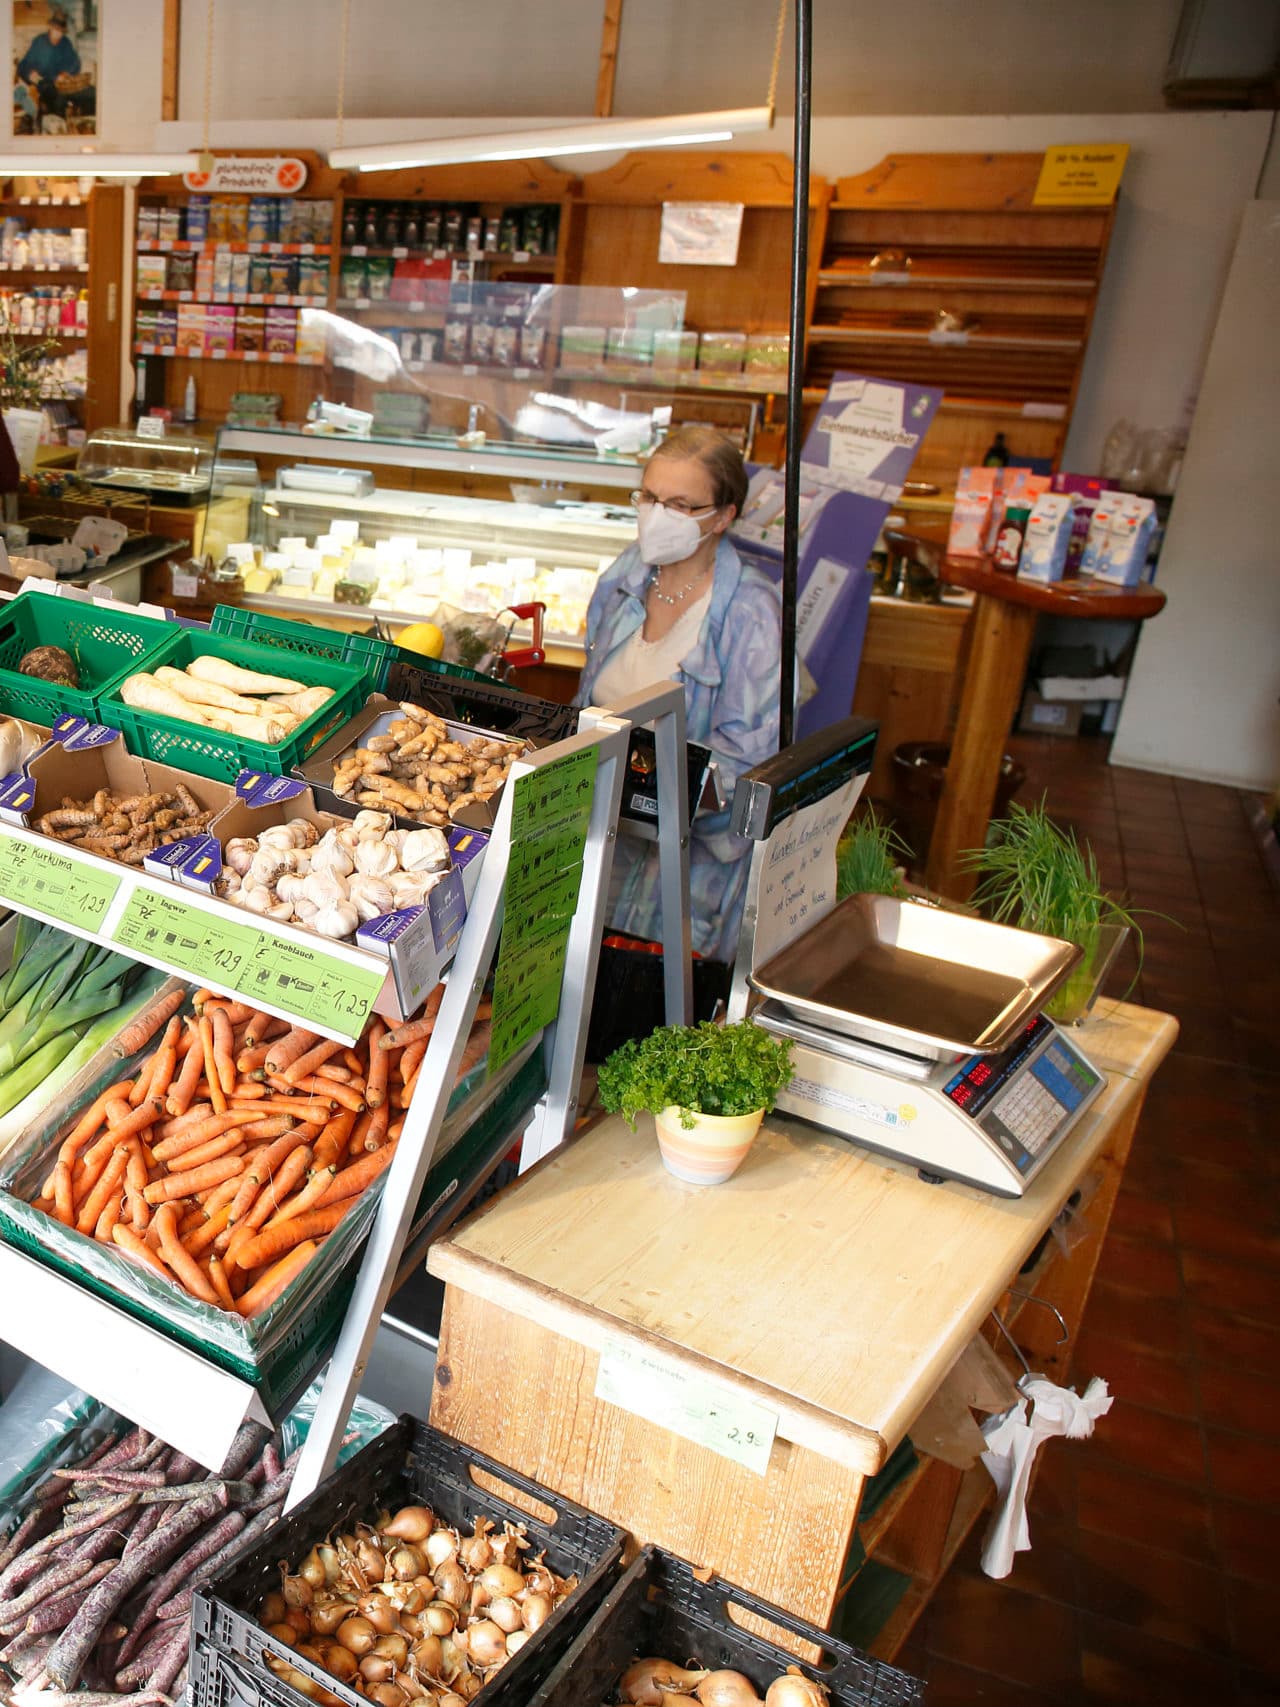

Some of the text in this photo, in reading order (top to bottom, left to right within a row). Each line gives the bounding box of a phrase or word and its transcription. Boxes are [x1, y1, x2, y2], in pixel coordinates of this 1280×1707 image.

[32, 847, 72, 872] Kurkuma
[78, 892, 107, 914] 1,29
[160, 899, 188, 915] Ingwer
[272, 939, 314, 961] Knoblauch
[333, 989, 369, 1017] 1,29
